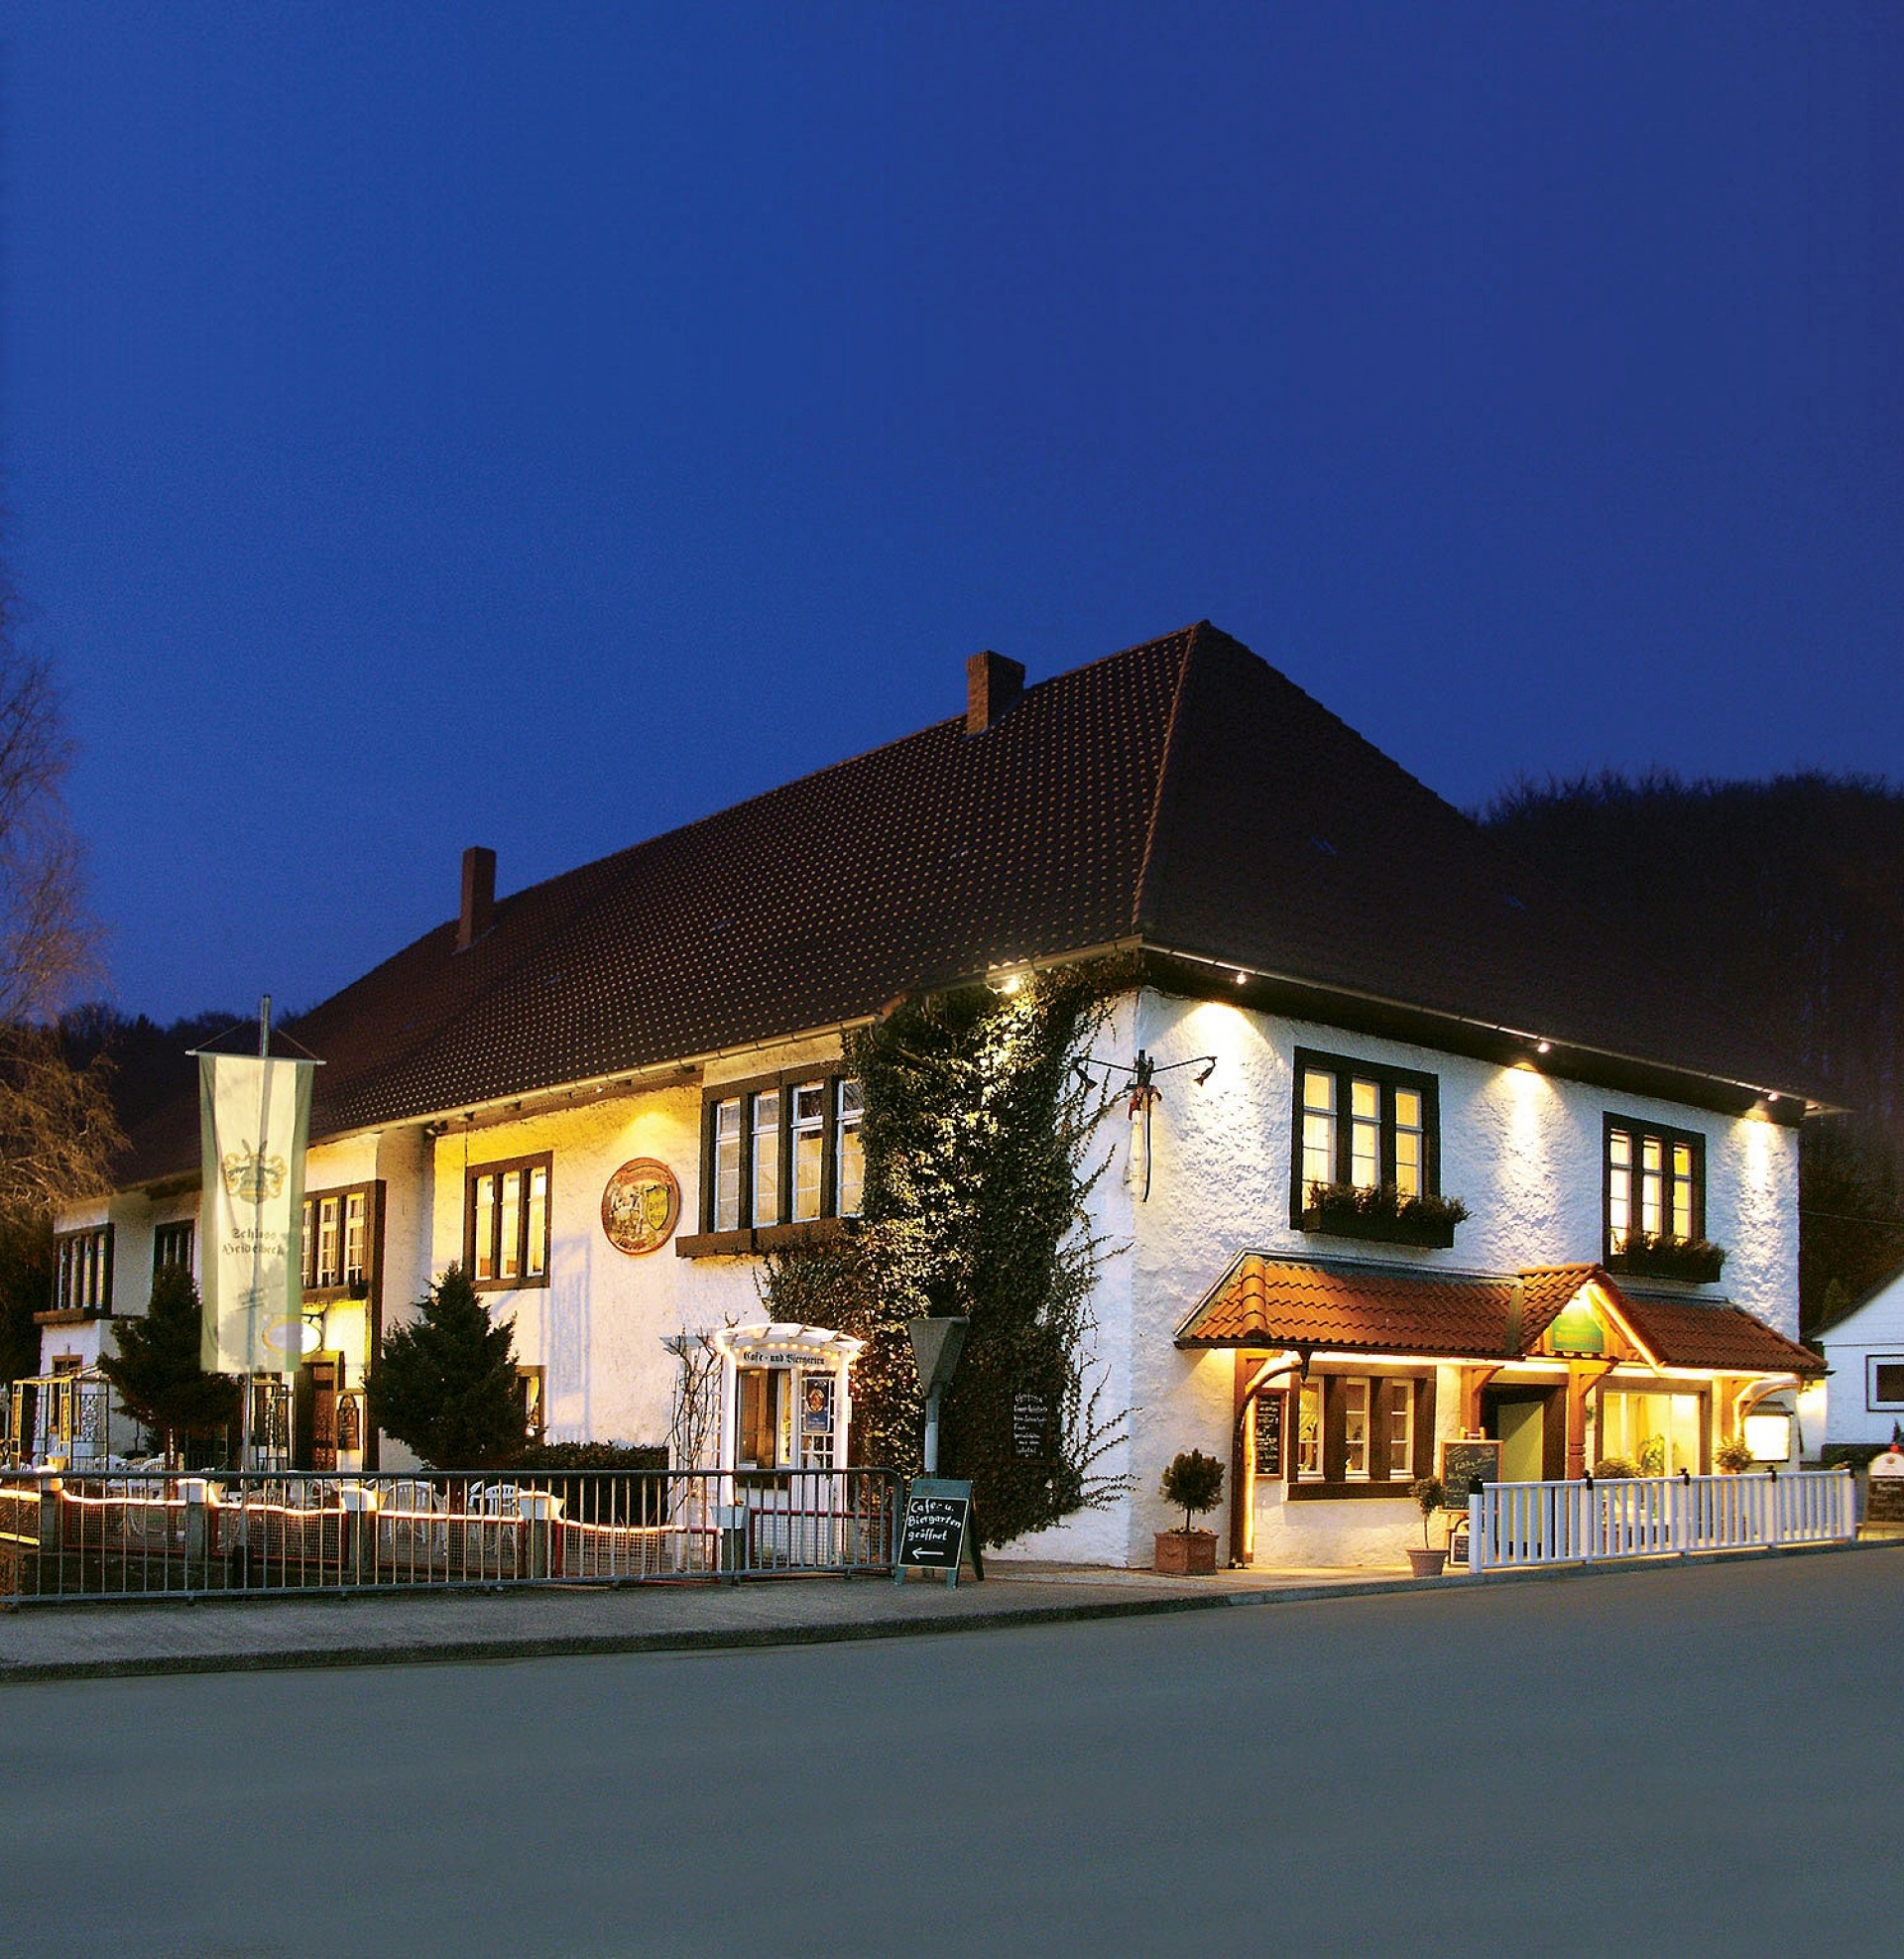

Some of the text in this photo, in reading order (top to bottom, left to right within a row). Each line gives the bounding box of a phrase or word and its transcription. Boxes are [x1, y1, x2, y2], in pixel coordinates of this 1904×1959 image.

[770, 1353, 783, 1362] und
[785, 1353, 825, 1366] Biergarten
[907, 1516, 961, 1529] Biergarten
[907, 1528, 947, 1541] geöffnet
